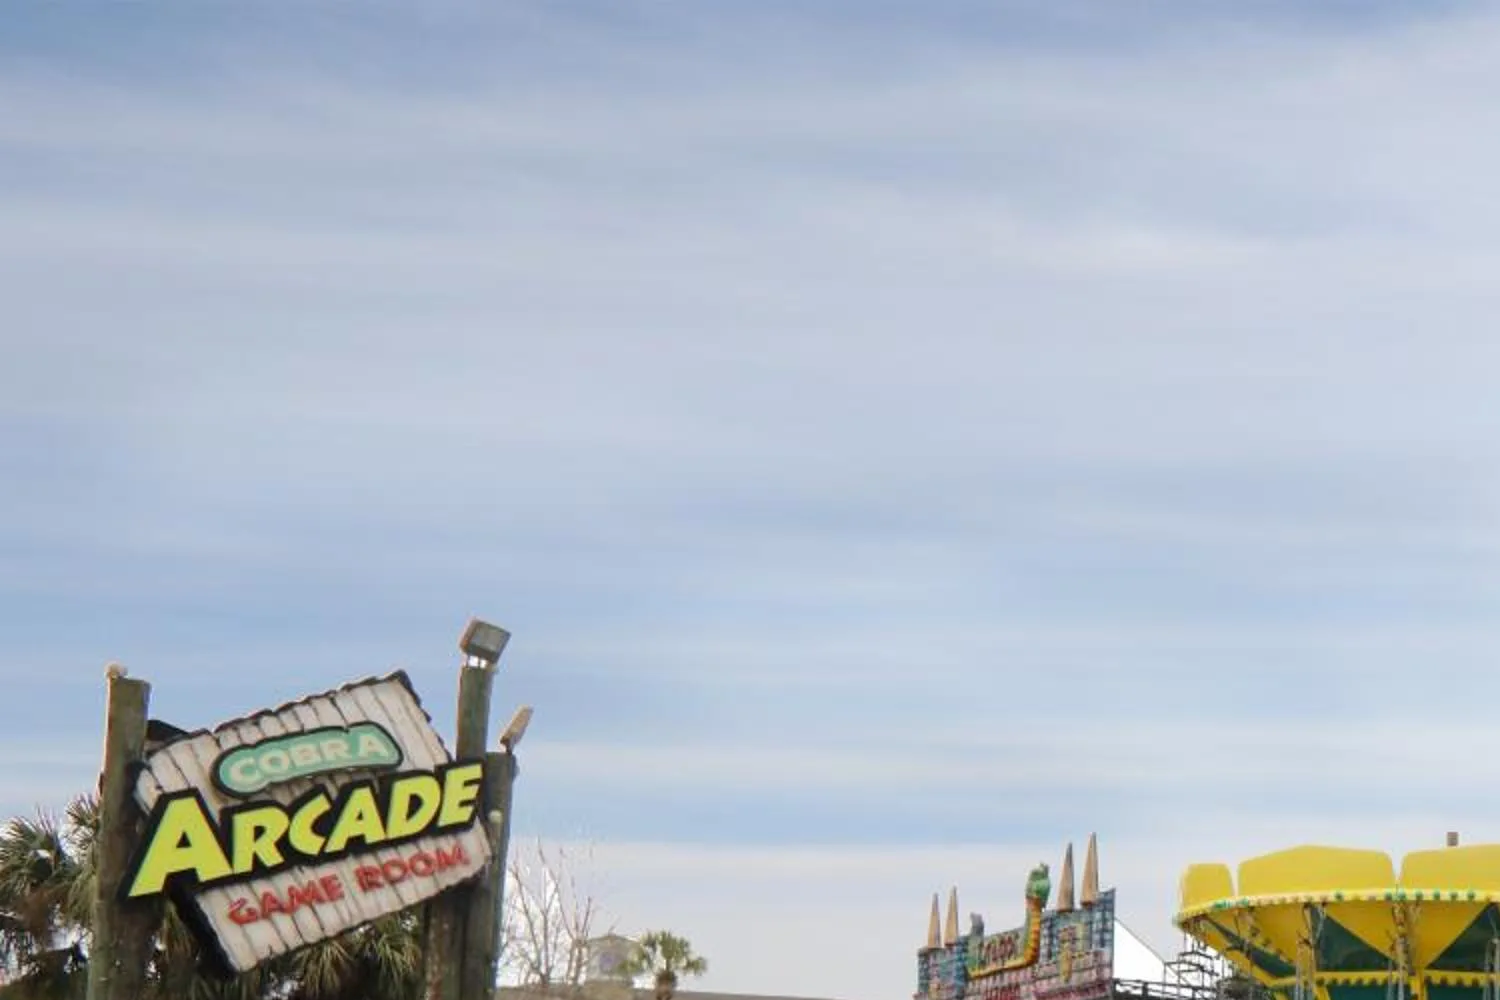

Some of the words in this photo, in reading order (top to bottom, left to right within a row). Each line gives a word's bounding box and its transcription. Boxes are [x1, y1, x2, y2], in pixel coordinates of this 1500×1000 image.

[229, 732, 390, 785] COBRA
[128, 763, 483, 897] ARCADE
[227, 874, 345, 926] GAME
[354, 843, 470, 893] ROOM
